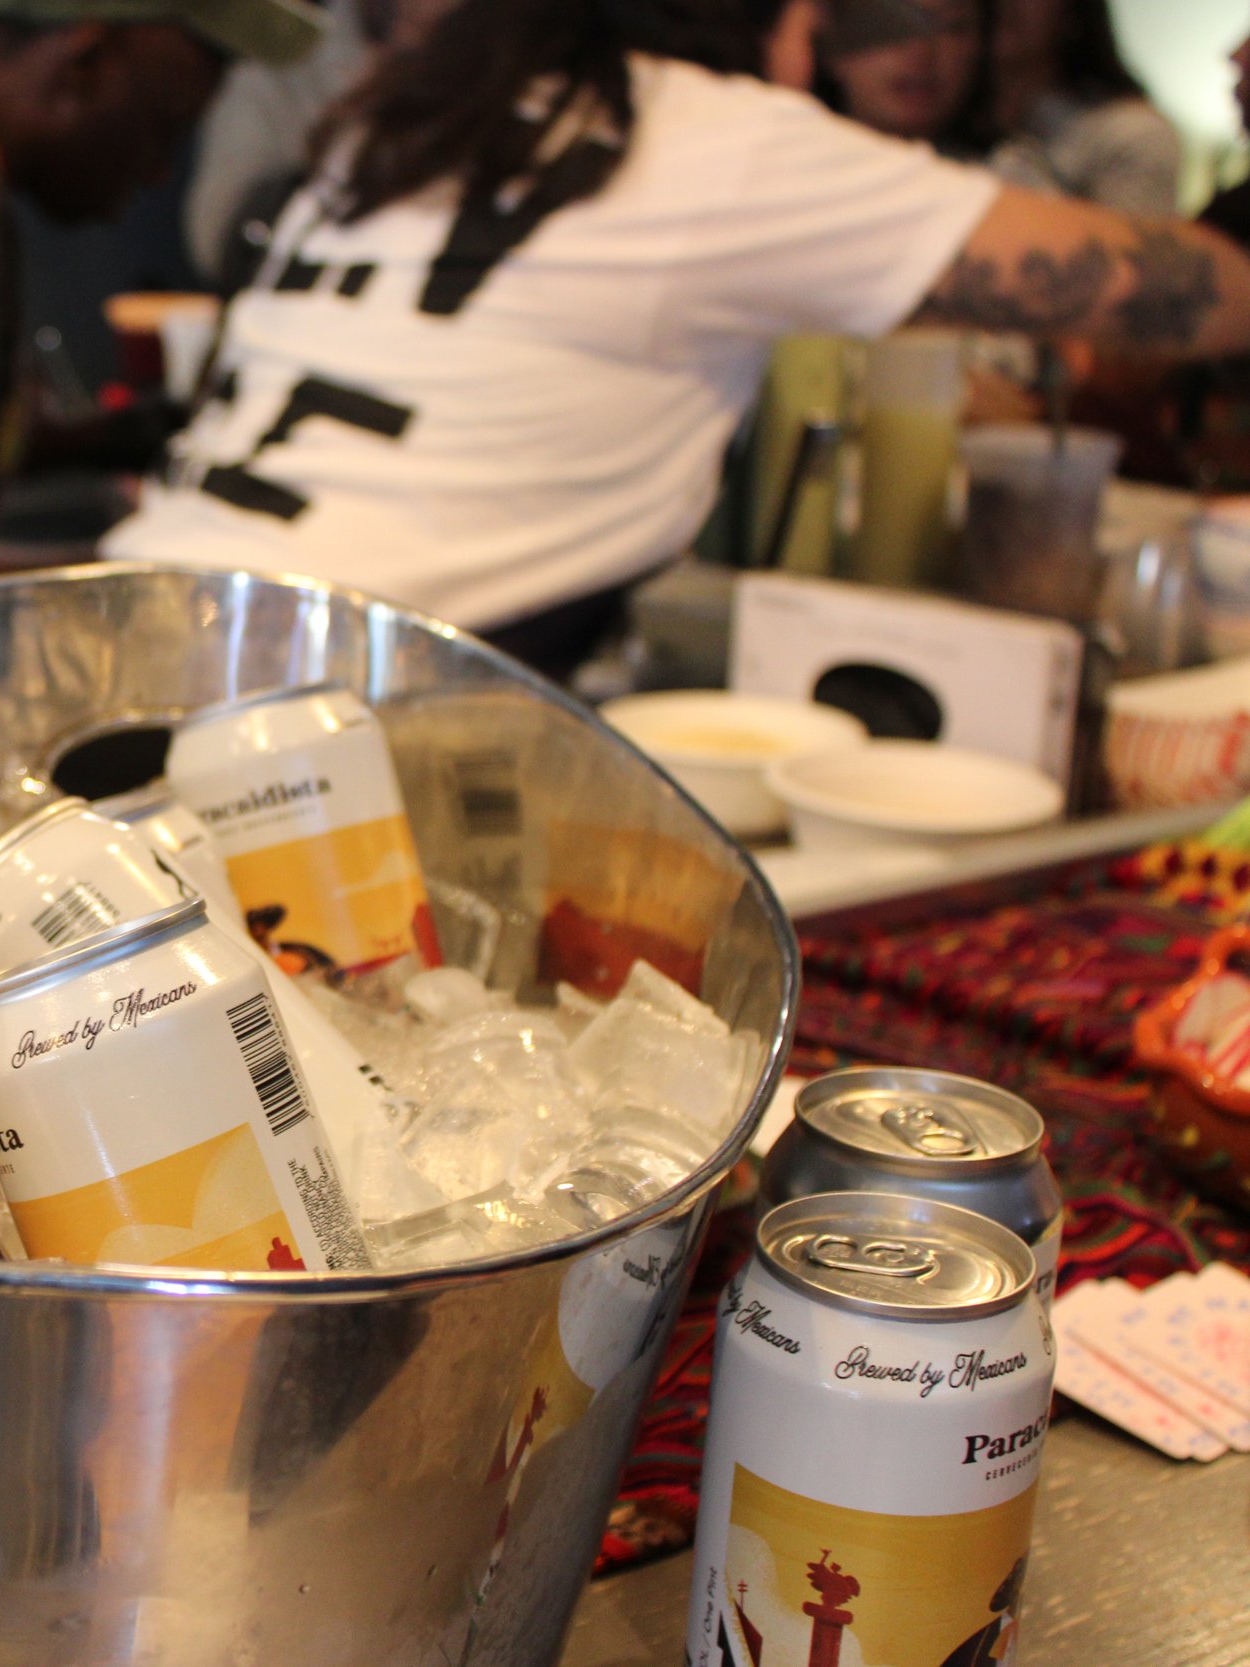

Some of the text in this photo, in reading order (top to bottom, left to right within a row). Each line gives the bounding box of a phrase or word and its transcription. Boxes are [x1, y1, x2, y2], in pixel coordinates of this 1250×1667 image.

[11, 981, 197, 1069] Brewed by Mexicans
[734, 1300, 800, 1354] Mexicans
[835, 1345, 1027, 1398] Brewed by Mexicans
